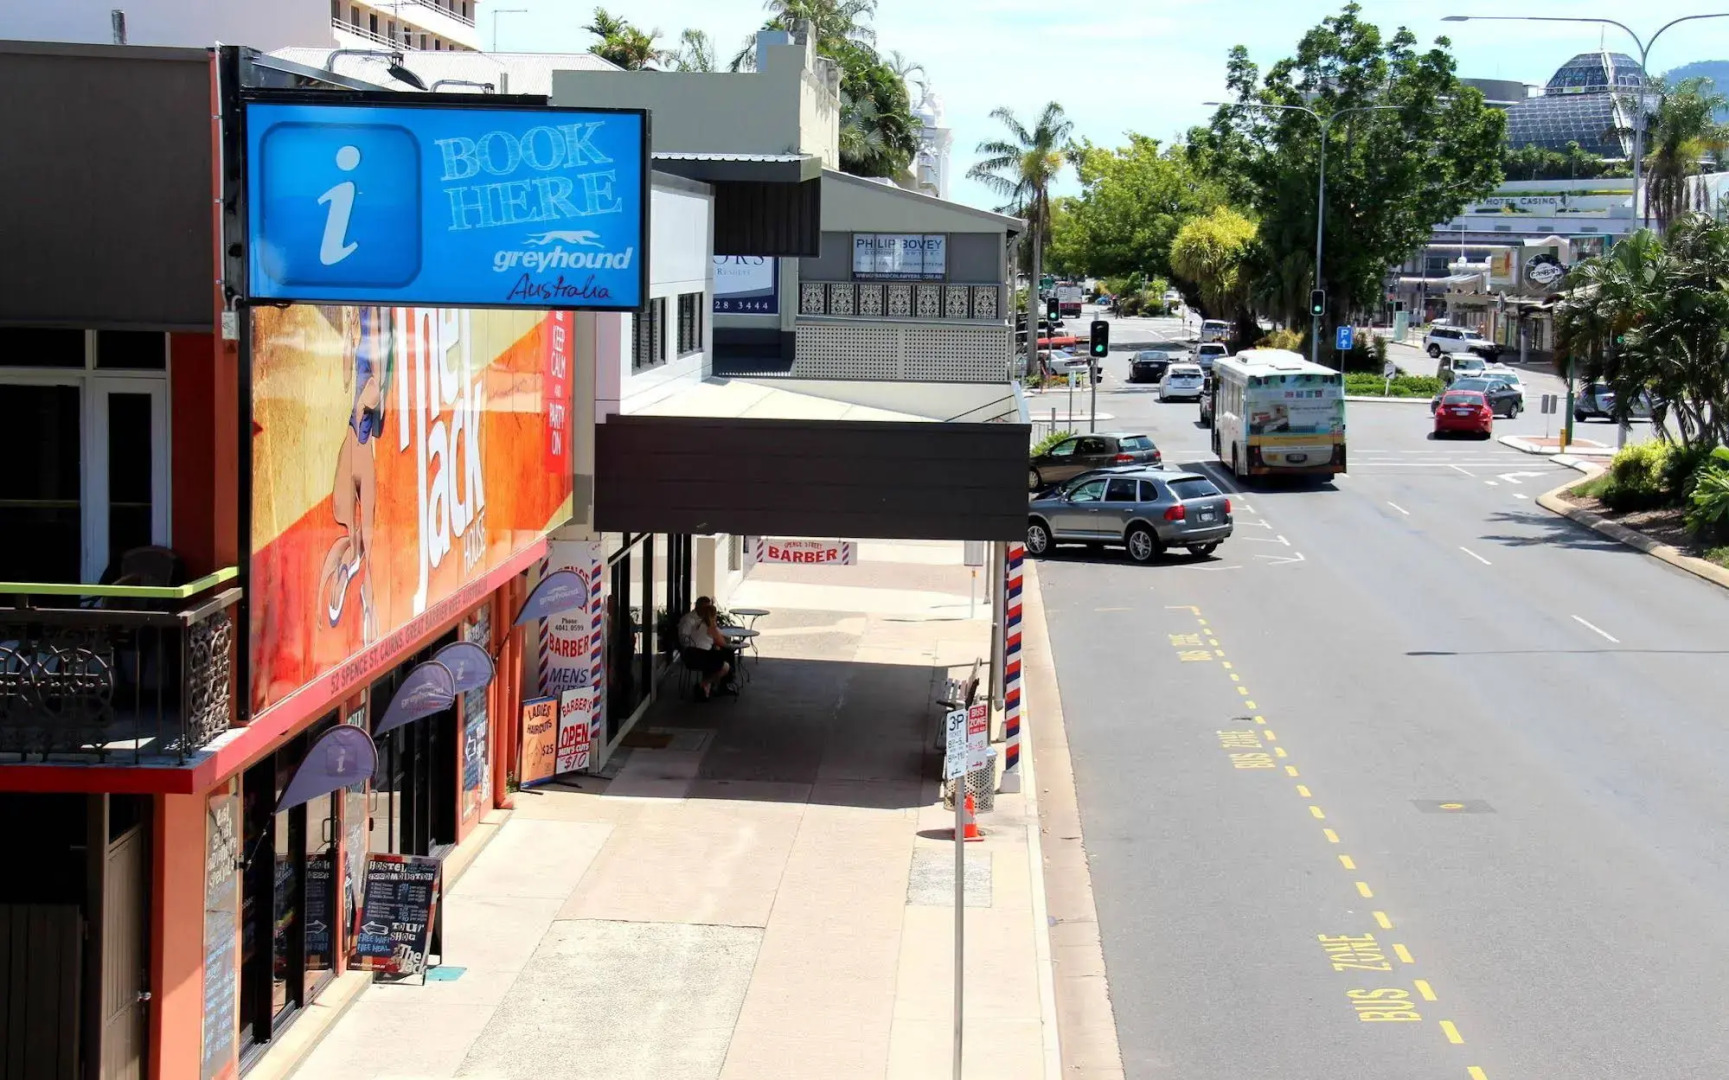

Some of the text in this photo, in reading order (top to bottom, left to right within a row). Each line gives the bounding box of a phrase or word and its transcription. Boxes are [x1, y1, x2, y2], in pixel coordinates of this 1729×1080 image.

[434, 121, 614, 182] BOOK
[442, 170, 622, 231] HERE
[856, 238, 942, 250] PHILIP BOVEY
[492, 245, 634, 273] greyhound
[506, 272, 612, 300] Australia
[738, 301, 768, 310] 3444
[768, 545, 838, 563] BARBER
[549, 632, 589, 658] BARBER
[341, 659, 369, 686] SPENCE
[528, 703, 551, 720] LADIES
[949, 713, 965, 731] 3P
[562, 722, 589, 748] OPEN
[542, 744, 554, 756] $25
[565, 752, 587, 768] $10
[369, 861, 407, 873] HOSTEL
[399, 943, 422, 963] The
[1317, 932, 1393, 972] ZONE
[1345, 987, 1423, 1022] BUS
